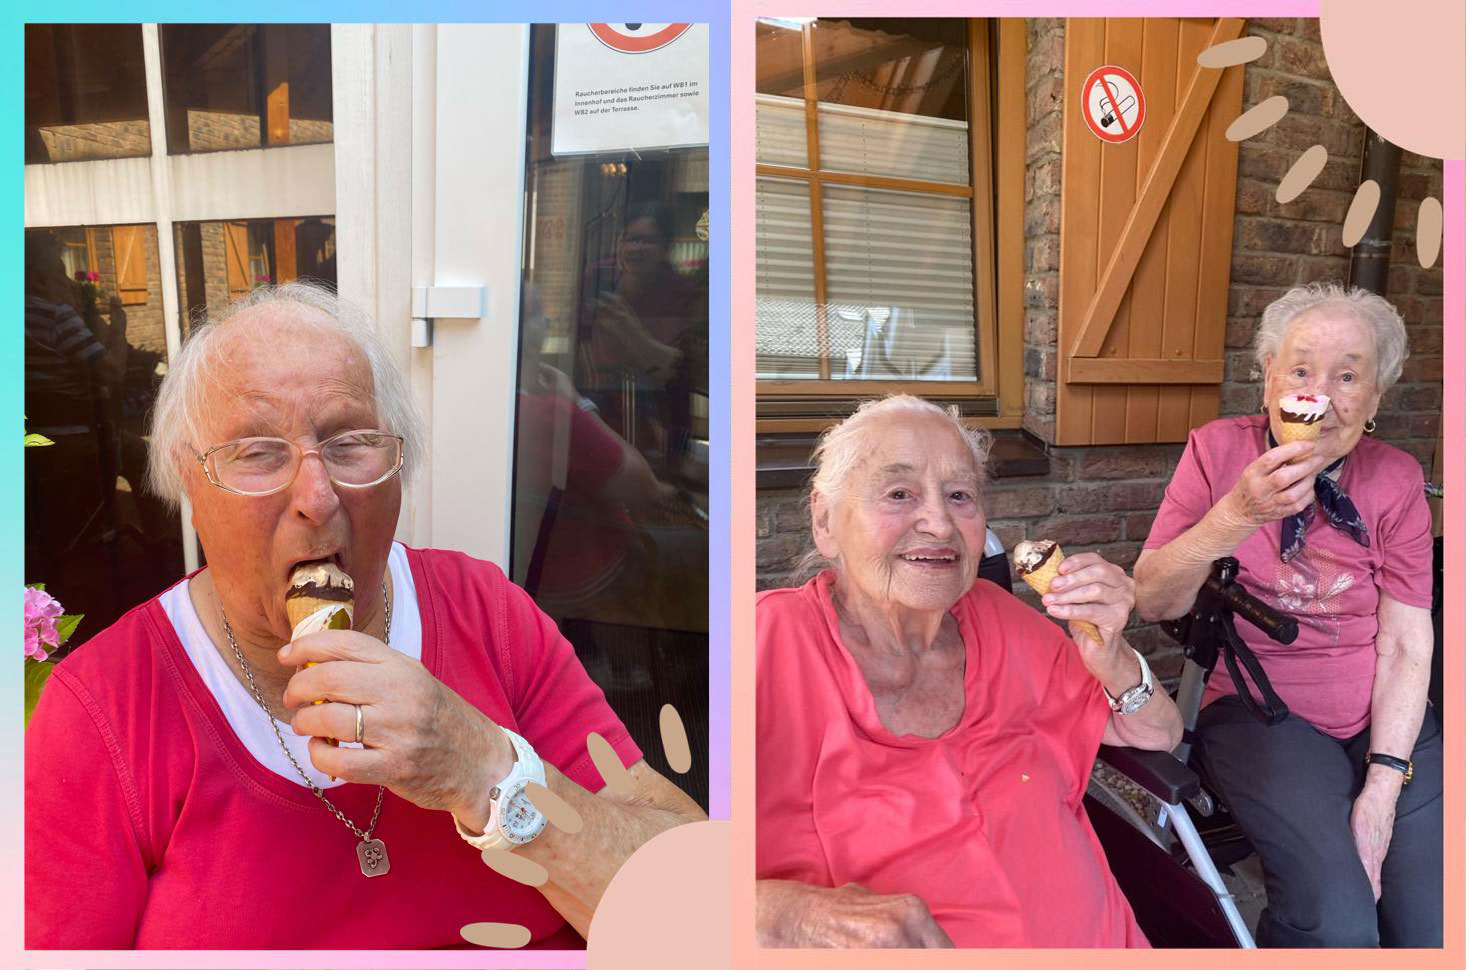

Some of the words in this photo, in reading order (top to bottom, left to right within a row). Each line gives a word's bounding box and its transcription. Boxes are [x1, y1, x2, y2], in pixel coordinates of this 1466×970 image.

[575, 87, 628, 98] Raucherbereiche
[628, 85, 649, 93] finden
[574, 98, 602, 106] Innenhof
[628, 92, 679, 102] Raucherzimmer
[574, 108, 588, 116] WB2
[589, 107, 600, 115] auf
[612, 105, 640, 113] Terrasse.
